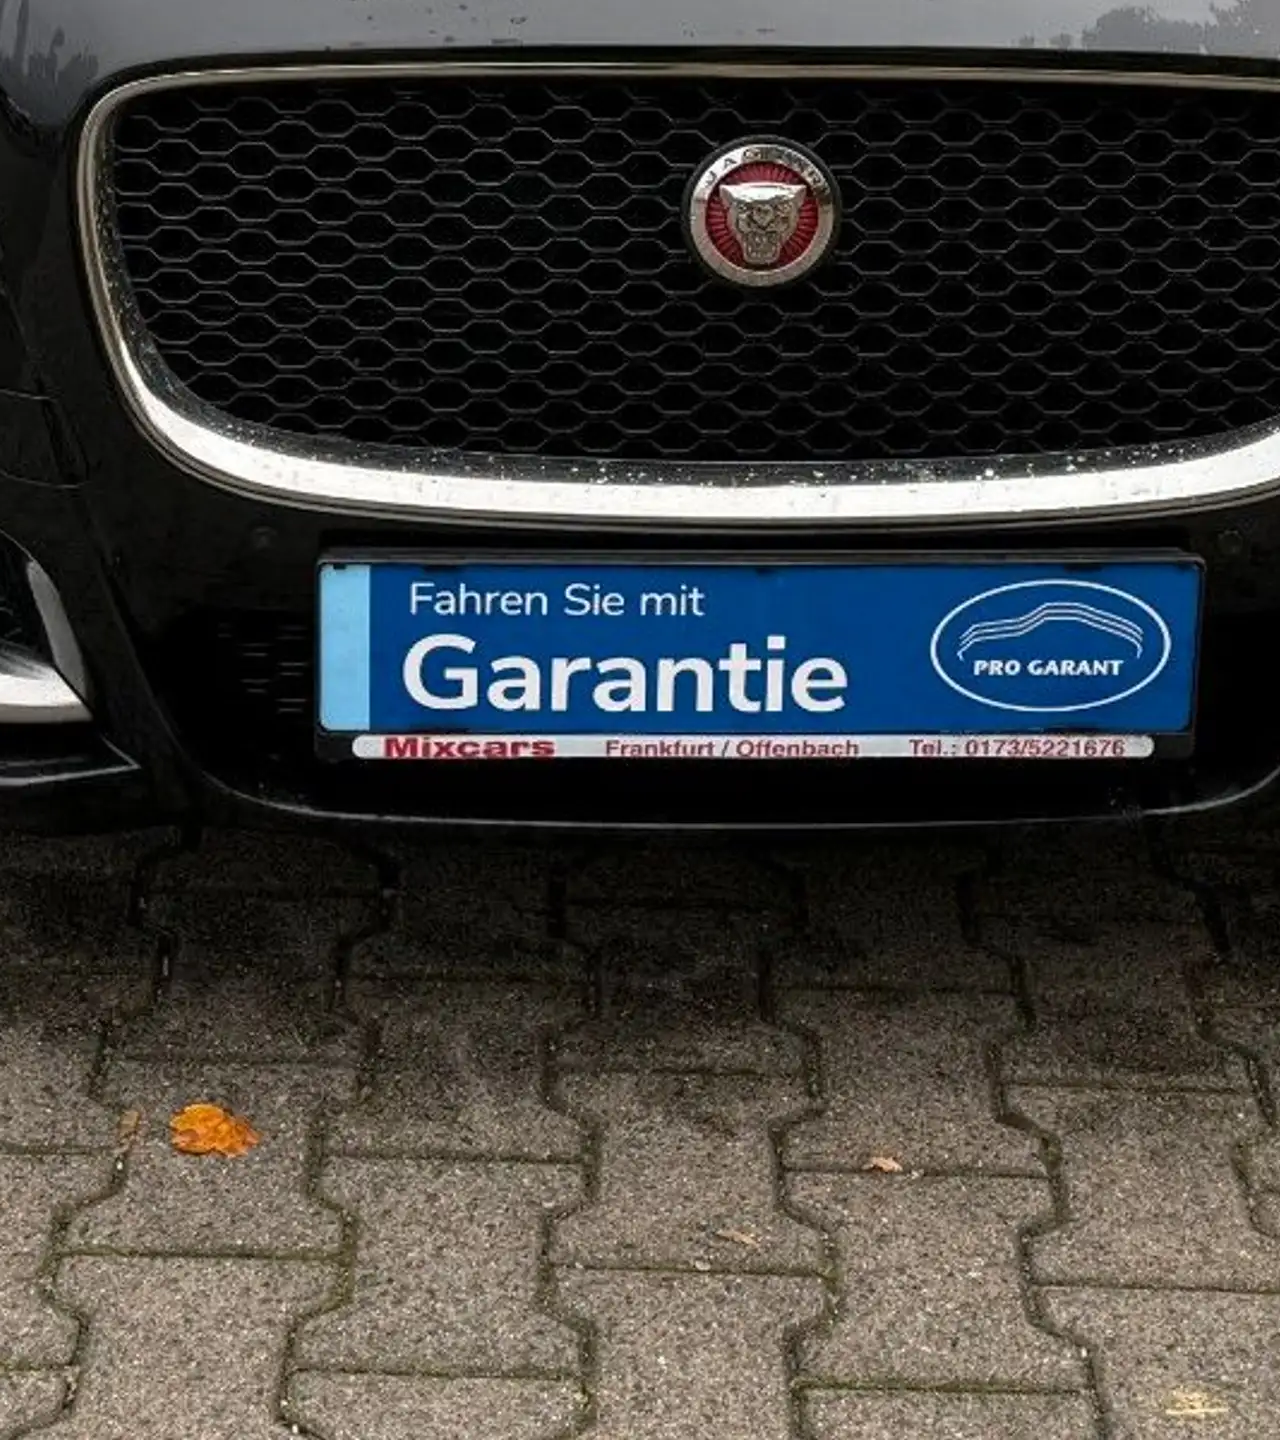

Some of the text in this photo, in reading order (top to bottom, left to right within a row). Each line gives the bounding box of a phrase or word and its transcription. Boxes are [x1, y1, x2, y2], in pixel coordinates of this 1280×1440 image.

[410, 582, 705, 616] Fahren Sie mit
[402, 633, 848, 712] Garantie
[973, 659, 1124, 677] PRO GARANT
[385, 737, 555, 758] Mixcars
[605, 739, 715, 758] Frankfurt
[736, 739, 859, 758] Offenbach
[909, 738, 957, 757] Tel.:
[965, 738, 1126, 757] 0173/5221676
